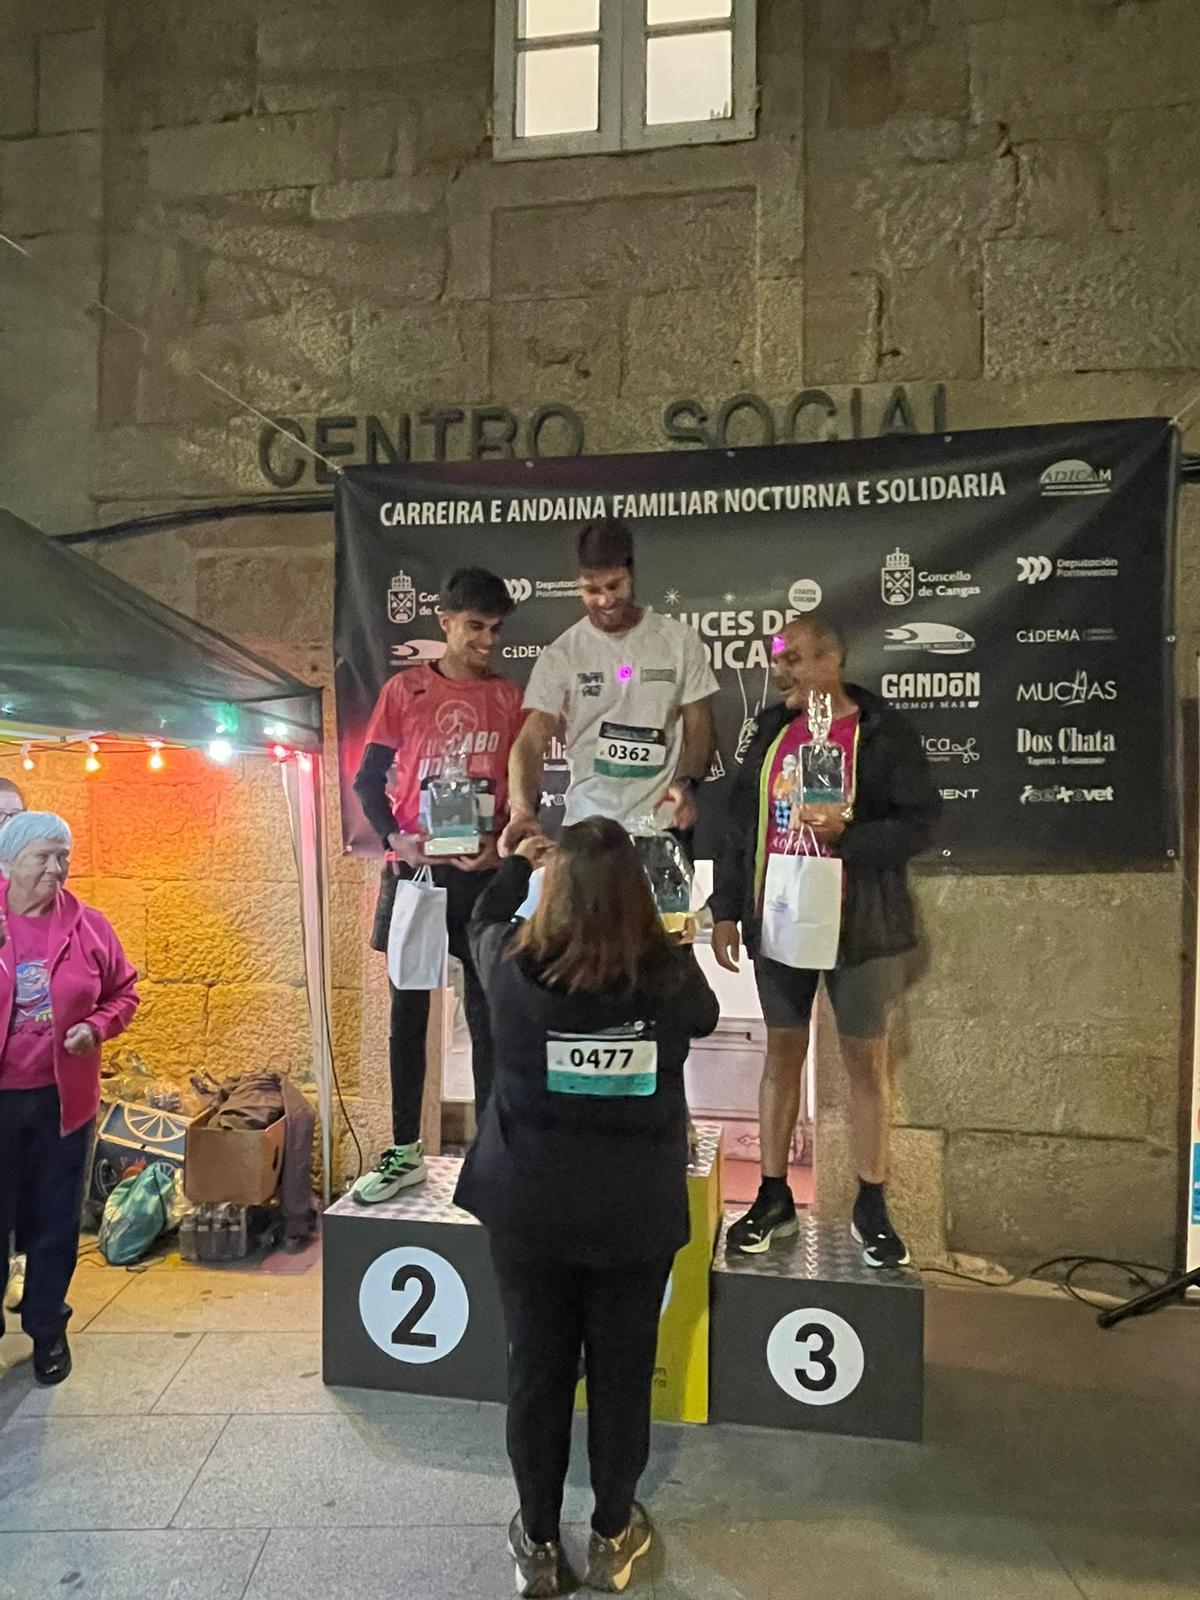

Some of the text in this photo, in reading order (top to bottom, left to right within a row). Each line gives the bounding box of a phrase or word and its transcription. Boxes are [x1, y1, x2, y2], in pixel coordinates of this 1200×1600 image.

[258, 402, 584, 488] CENTRO
[380, 471, 1006, 526] CARREIRA E ANDAINA FAMILIAR NOCTURNA E SOLIDARIA
[918, 571, 971, 582] Concello
[918, 585, 980, 598] de Cangas
[1016, 669, 1118, 707] MUCHAS
[608, 743, 650, 761] 0362
[1017, 726, 1116, 753] Dos Chata
[570, 1048, 633, 1069] 0477
[391, 1264, 437, 1349] 2
[793, 1322, 838, 1393] 3
